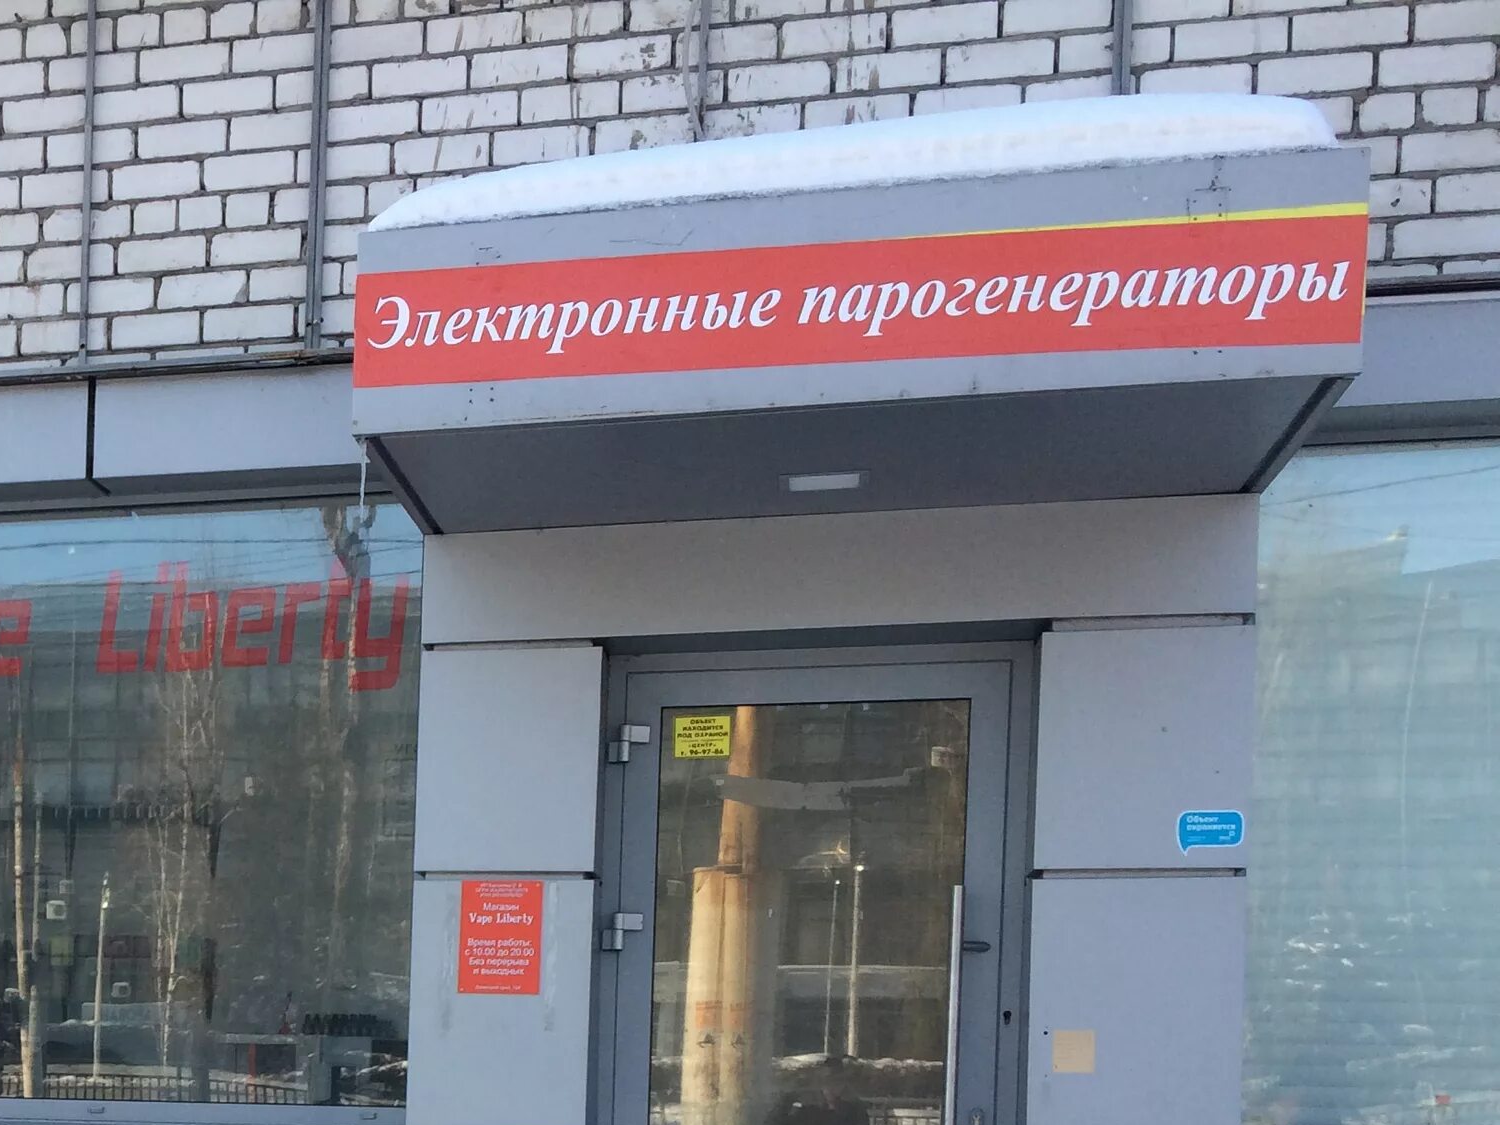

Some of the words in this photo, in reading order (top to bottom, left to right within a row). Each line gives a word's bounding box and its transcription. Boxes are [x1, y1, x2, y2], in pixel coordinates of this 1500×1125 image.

[366, 287, 782, 355] Электронные
[797, 259, 1351, 337] парогенераторы
[96, 560, 410, 695] Liberty
[469, 912, 493, 925] Vape
[496, 912, 534, 926] Liberty
